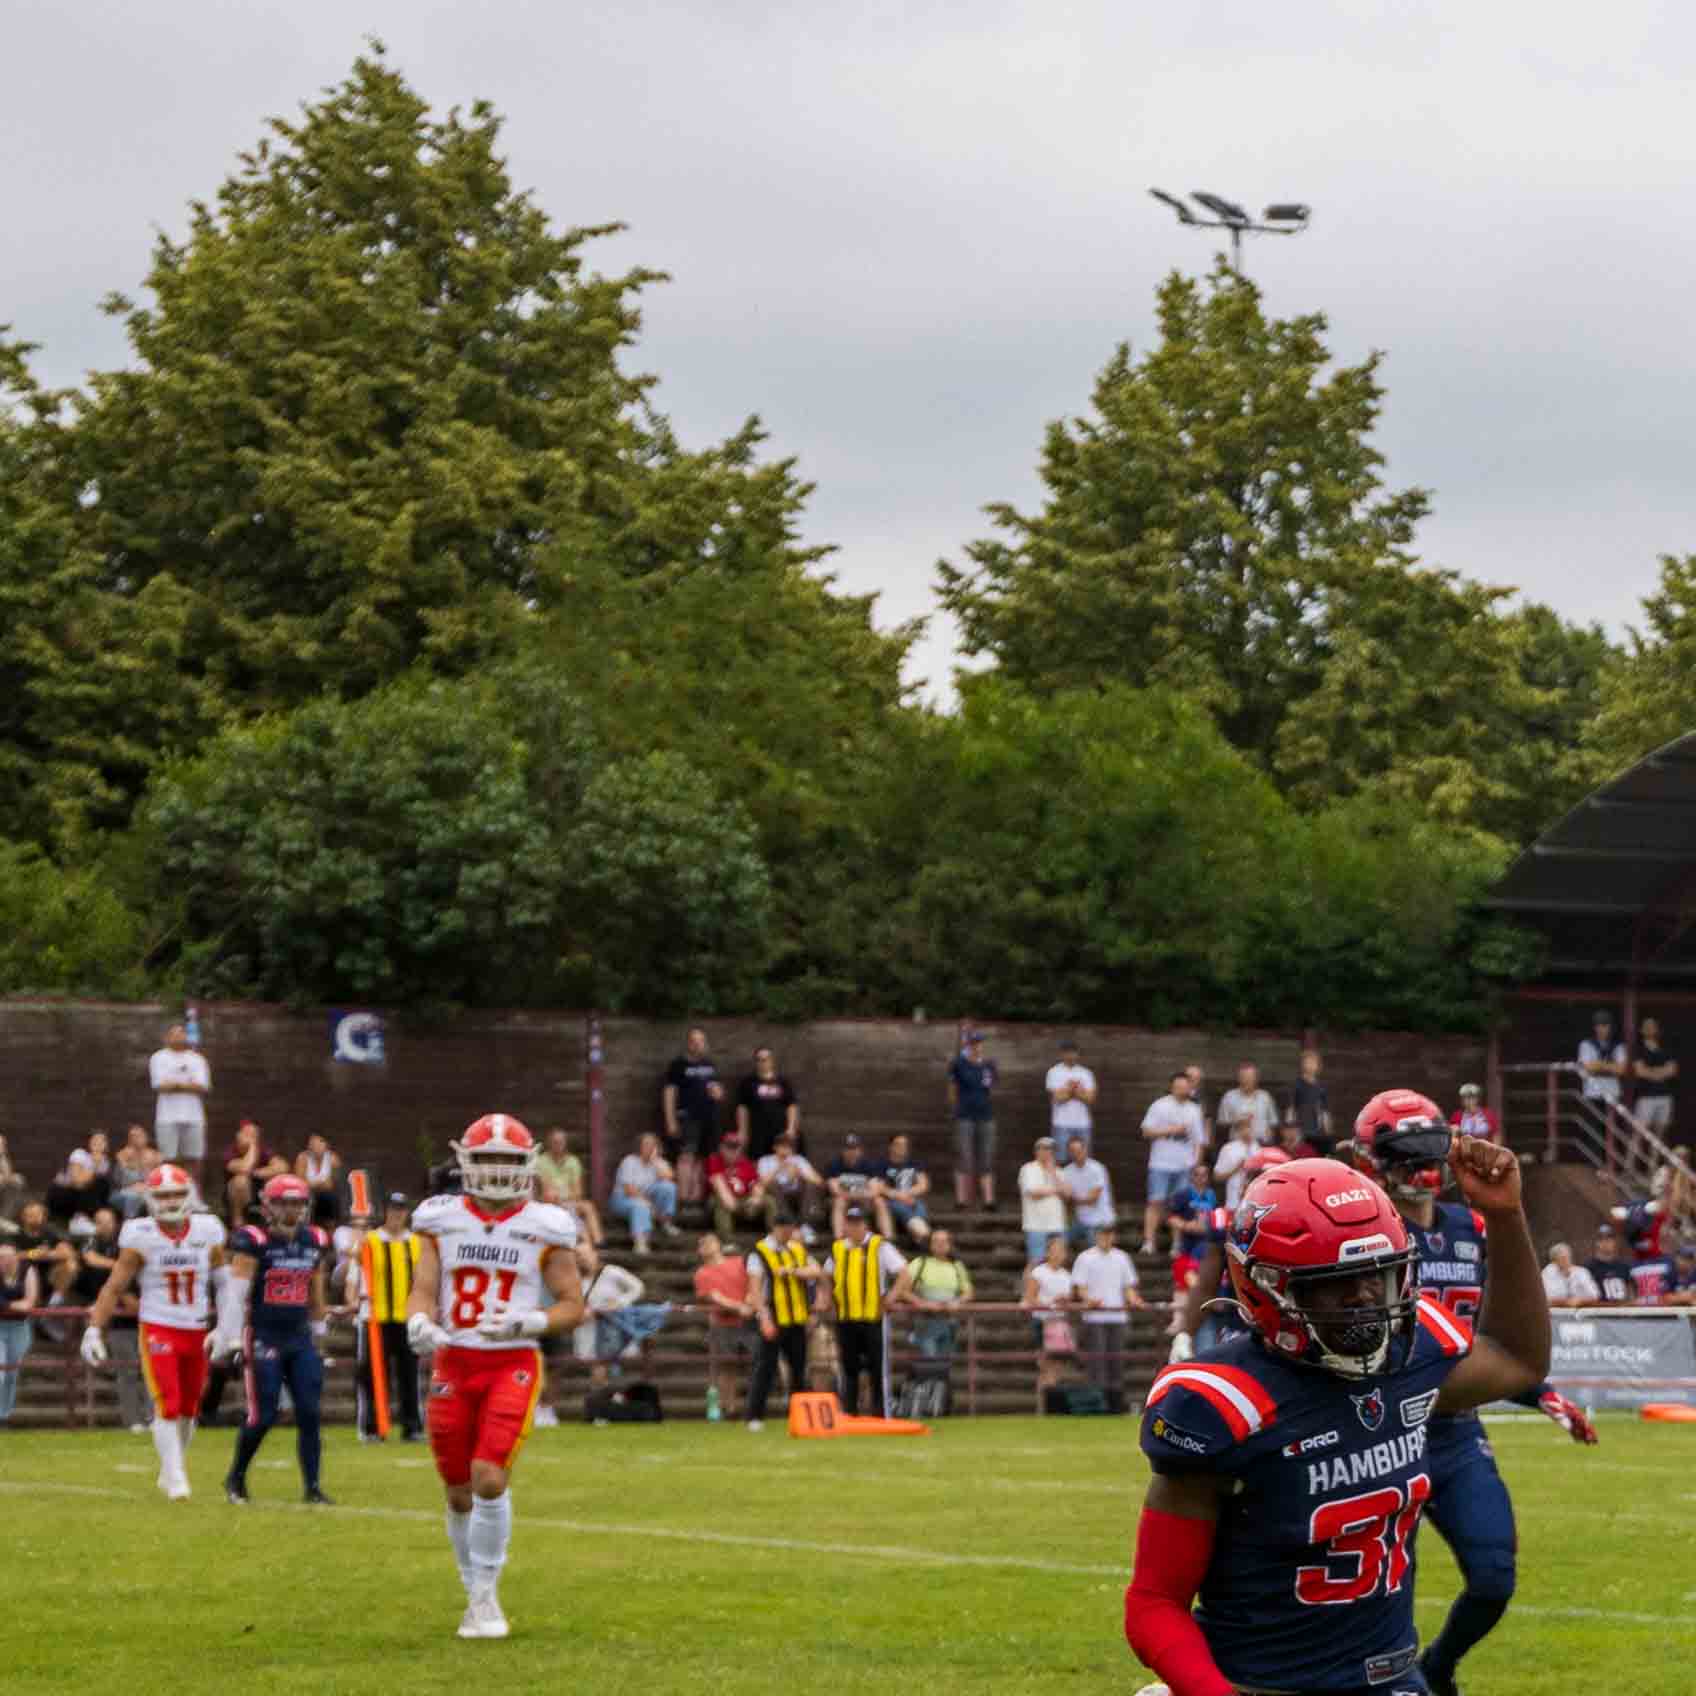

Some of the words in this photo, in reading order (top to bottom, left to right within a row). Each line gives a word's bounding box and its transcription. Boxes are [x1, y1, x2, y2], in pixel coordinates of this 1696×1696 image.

[335, 1012, 384, 1062] G
[1325, 1188, 1373, 1208] GAZI
[457, 1243, 519, 1264] MADRID
[163, 1270, 196, 1305] 11
[1417, 1262, 1477, 1282] MBURG
[800, 1401, 834, 1429] 10
[1307, 1424, 1427, 1495] HAMBUR
[1295, 1473, 1430, 1605] 31
